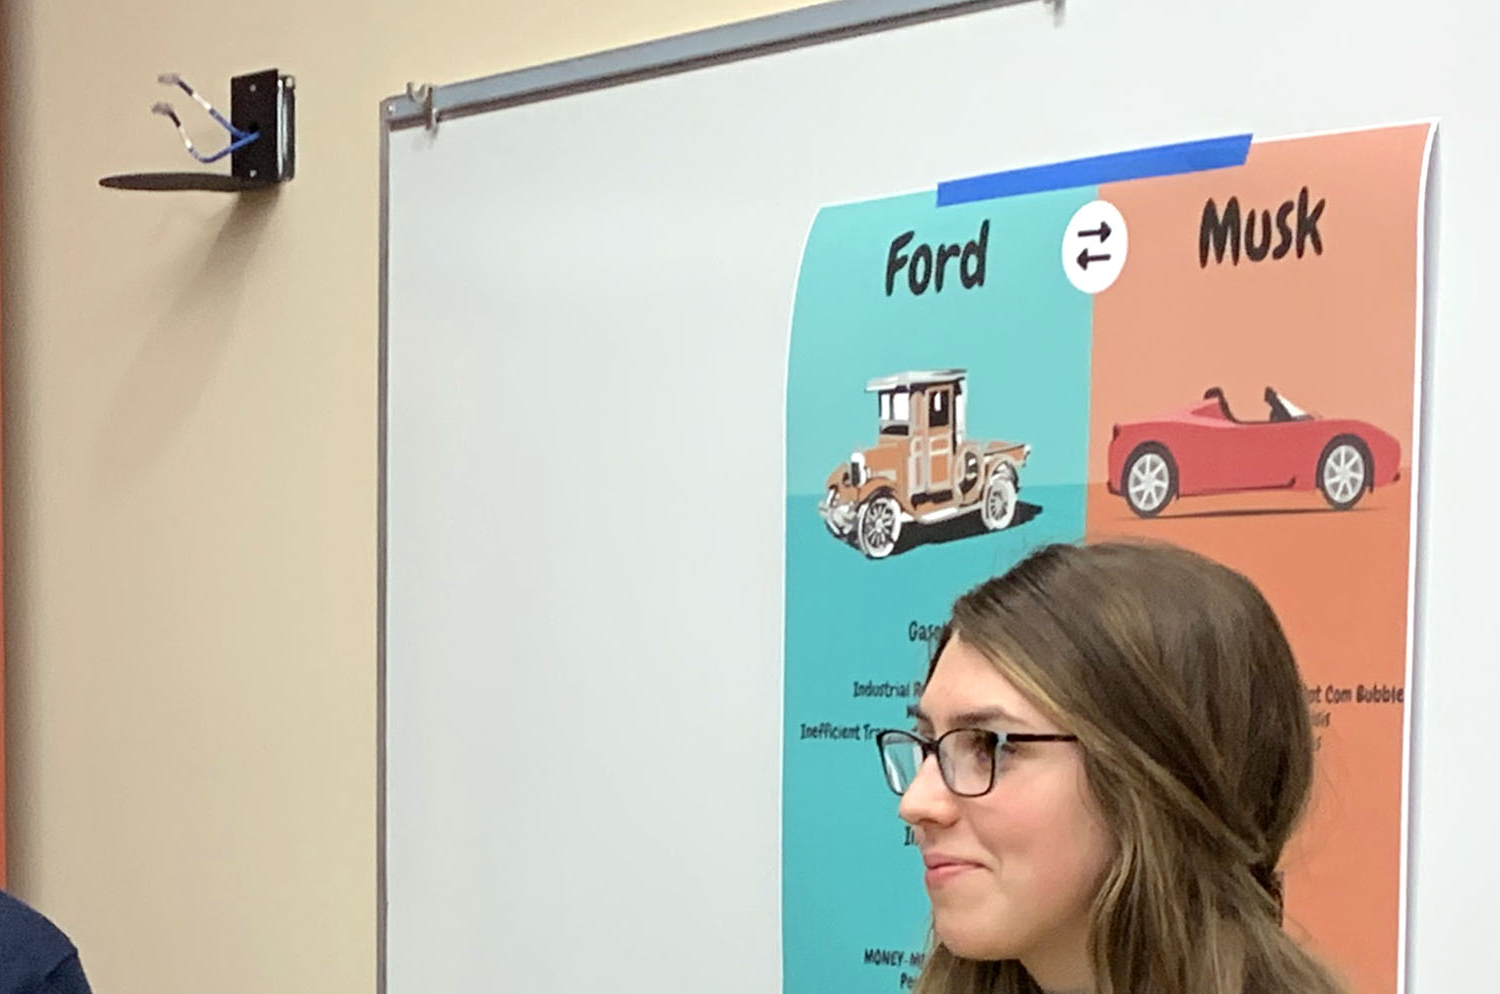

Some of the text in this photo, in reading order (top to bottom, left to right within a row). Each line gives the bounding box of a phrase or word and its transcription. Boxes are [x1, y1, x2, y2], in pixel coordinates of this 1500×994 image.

[1199, 186, 1327, 269] Musk
[885, 219, 991, 297] Ford
[853, 680, 910, 698] Industrial
[1325, 685, 1352, 703] Com
[1356, 683, 1404, 704] Bubble
[800, 723, 860, 741] Inefficient
